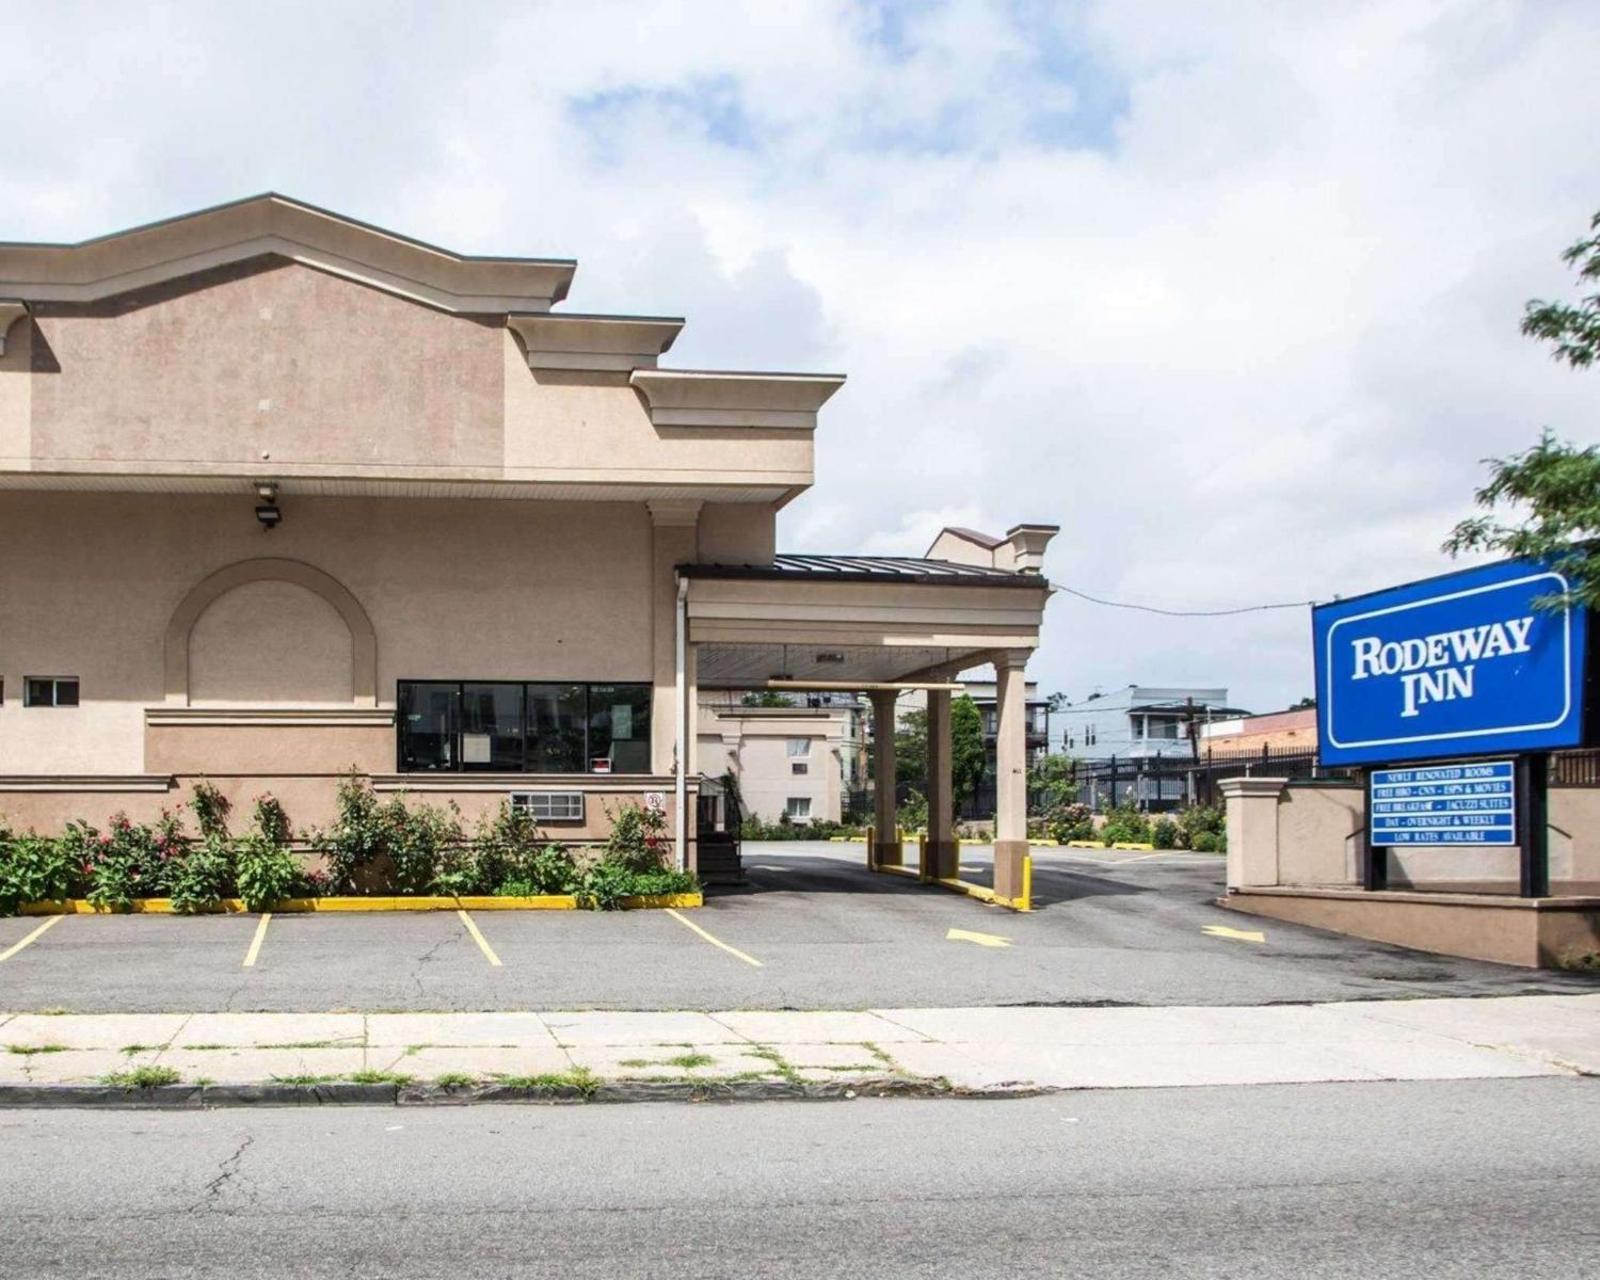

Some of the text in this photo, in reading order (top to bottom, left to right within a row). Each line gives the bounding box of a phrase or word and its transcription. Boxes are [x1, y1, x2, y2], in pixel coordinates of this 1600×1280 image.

[1351, 617, 1534, 680] RODEWAY
[1400, 665, 1475, 718] INN
[1415, 769, 1461, 781] RENOVATED
[1464, 767, 1494, 778] ROOMS
[1377, 788, 1393, 798] FREE
[1418, 785, 1436, 796] CNN
[1444, 784, 1463, 795] ESPN
[1465, 784, 1472, 794] &
[1474, 782, 1506, 793] MOVIES
[1375, 803, 1391, 813] FREE
[1446, 799, 1478, 811] JACUZZI
[1480, 798, 1509, 809] SUITES
[1407, 815, 1451, 827] OVERNIGHT
[1453, 816, 1460, 825] &
[1463, 815, 1495, 825] WEEKLY
[1394, 831, 1486, 842] LOW RATES AVAILABLE
